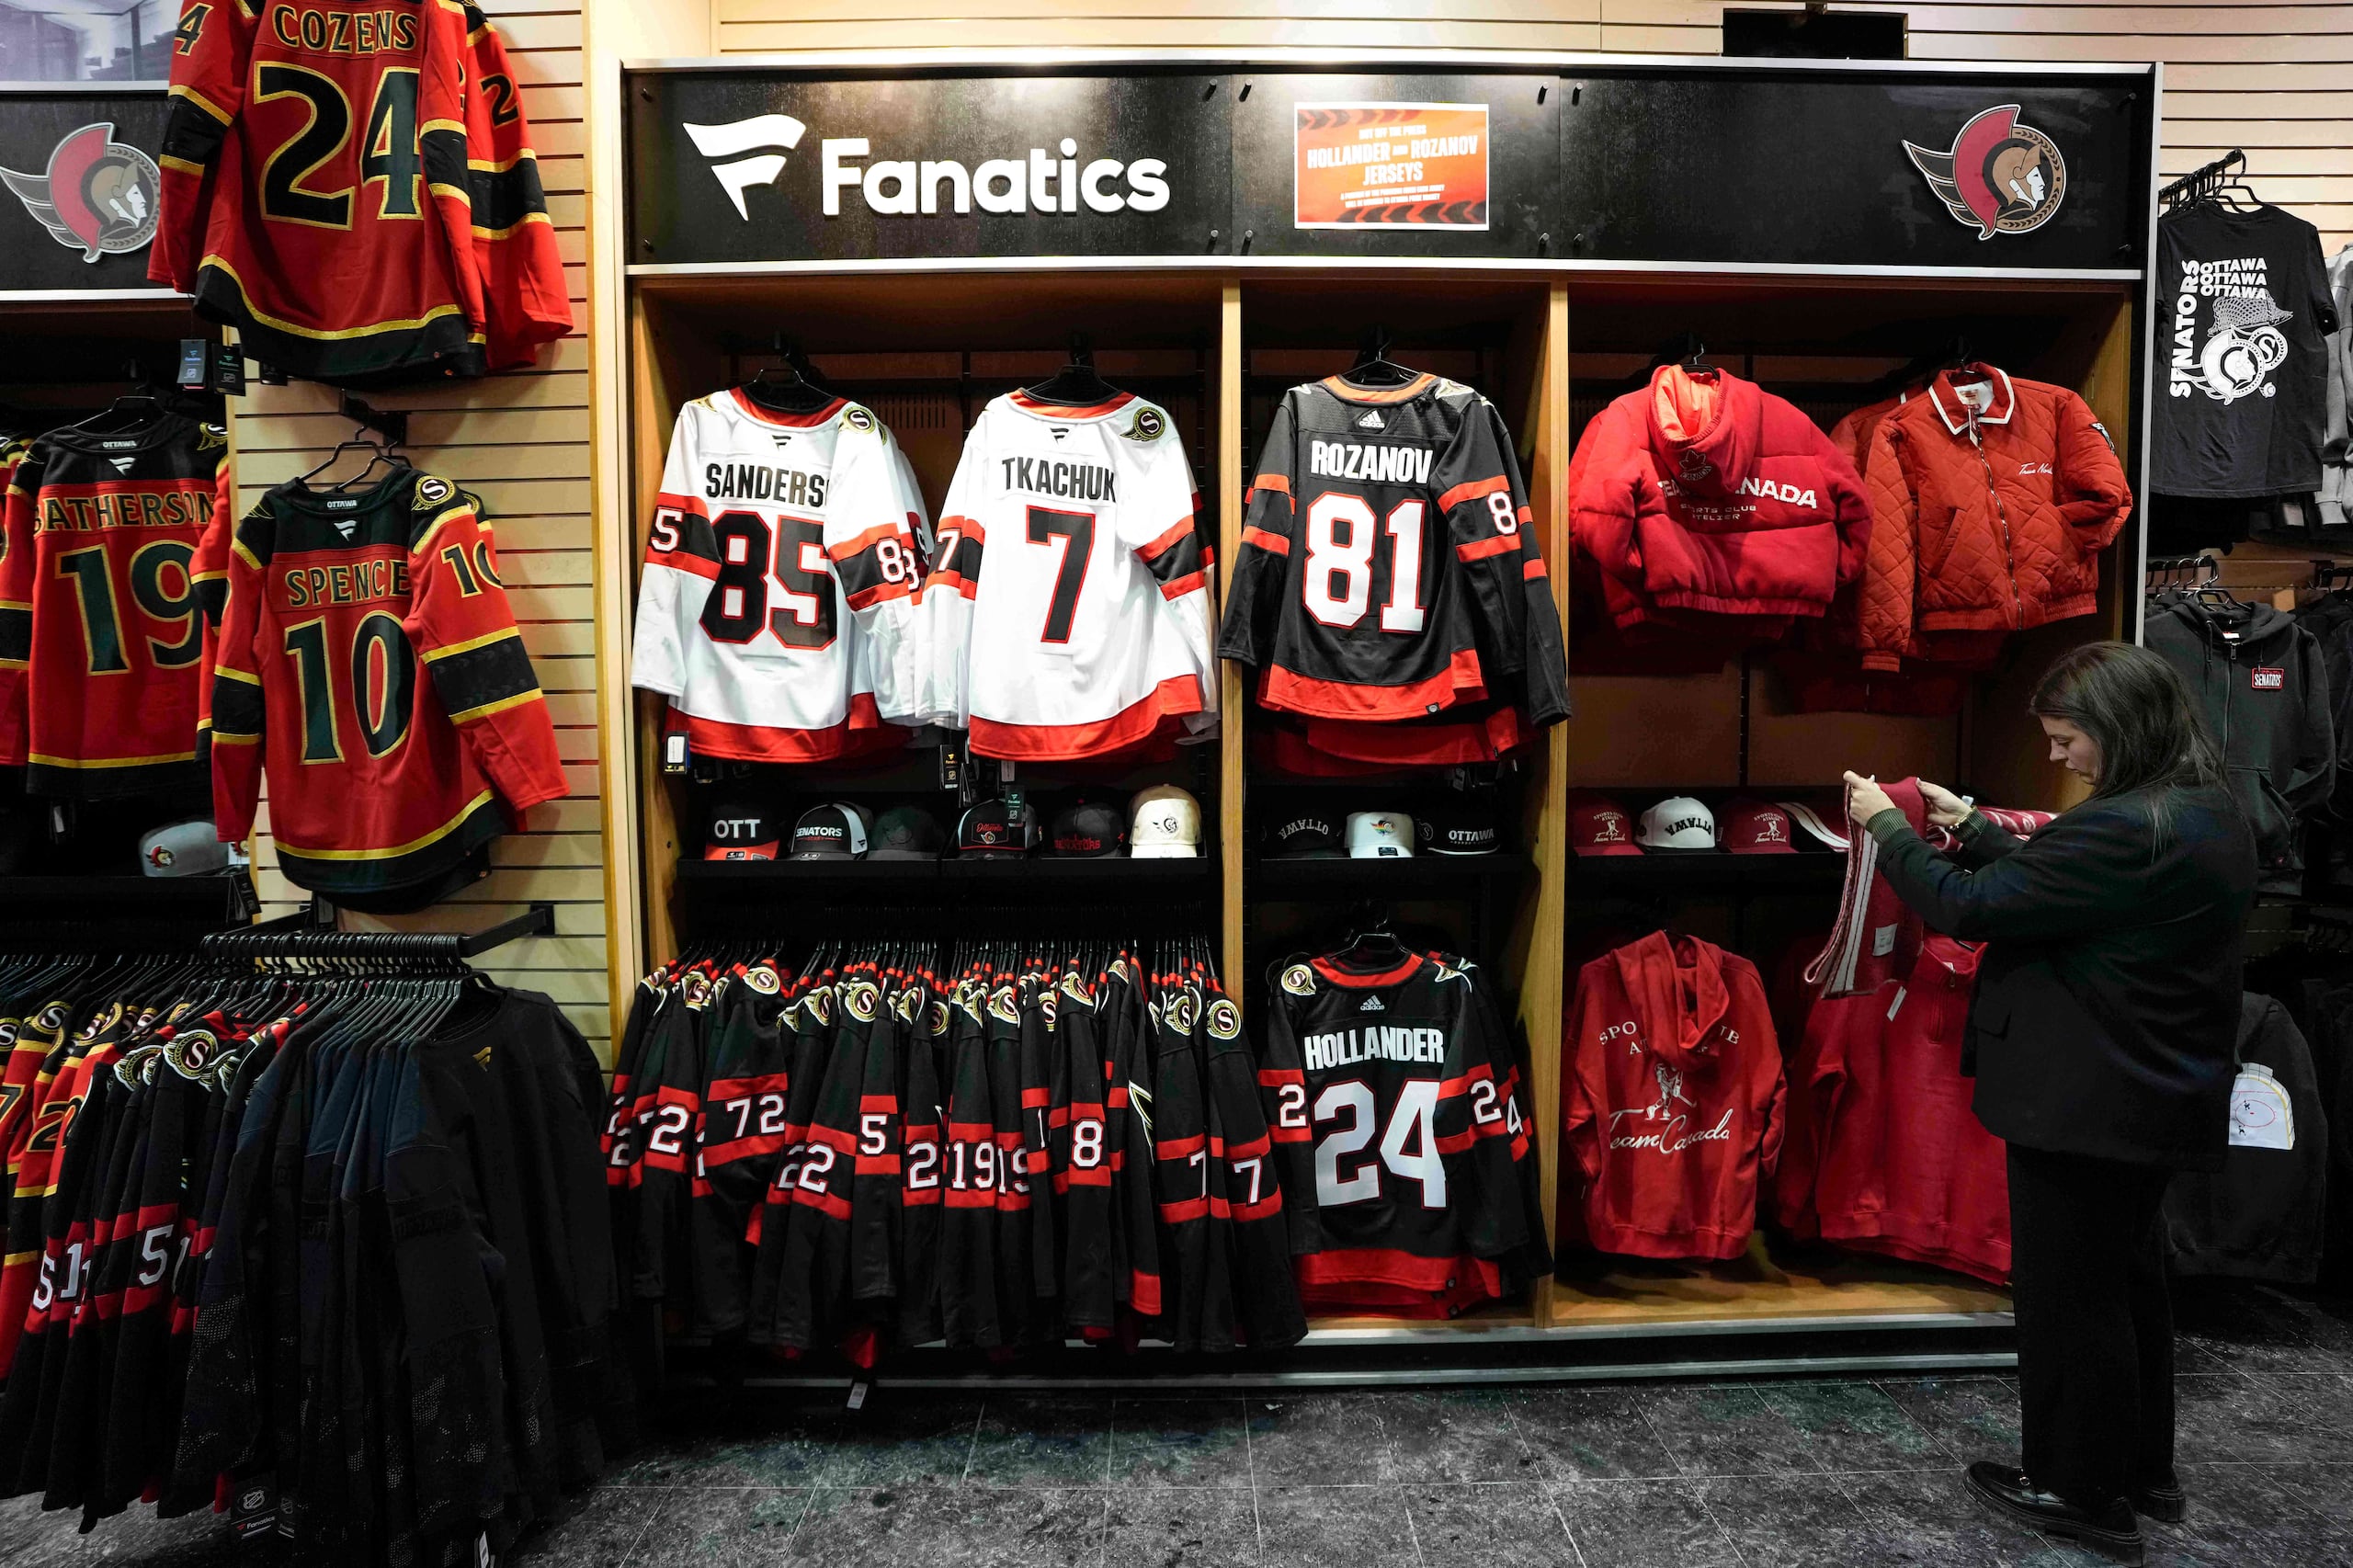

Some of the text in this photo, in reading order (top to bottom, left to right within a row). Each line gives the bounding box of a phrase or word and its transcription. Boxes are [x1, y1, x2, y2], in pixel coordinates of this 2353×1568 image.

[272, 4, 418, 54] COZENS
[480, 74, 519, 129] 2
[254, 60, 424, 231] 24
[1307, 142, 1391, 169] HOLLANDER
[1411, 135, 1478, 159] ROZANOV
[821, 138, 1171, 216] Fanatics
[1362, 162, 1423, 186] JERSEYS
[2200, 257, 2268, 274] OTTAWA
[2200, 273, 2268, 286] OTTAWA
[2200, 284, 2267, 301] OTTAWA
[2169, 259, 2200, 399] SENATORS
[103, 440, 137, 449] OTTAWA
[1358, 420, 1385, 428] adidas
[706, 462, 829, 507] SANDERS
[1002, 456, 1116, 503] TKACHUK
[1310, 440, 1433, 484] ROZANOV
[327, 500, 358, 508] OTTAWA
[1486, 489, 1517, 535] 8
[1735, 476, 1817, 509] NADA
[650, 506, 683, 551] 5
[937, 529, 962, 573] 7
[699, 510, 837, 652] 85
[1026, 505, 1096, 643] 7
[1302, 492, 1427, 634] 81
[54, 540, 203, 676] 19
[285, 610, 417, 765] 10
[2254, 672, 2281, 687] SENATORS
[713, 818, 761, 839] OTT
[795, 826, 843, 837] SENATORS
[1448, 828, 1495, 840] OTTAWA
[1360, 1003, 1385, 1011] adidas
[1303, 1025, 1445, 1071] HOLLANDER
[726, 1094, 785, 1139] 72
[1279, 1083, 1308, 1128] 2
[1471, 1078, 1503, 1125] 2
[649, 1104, 690, 1154] 2
[860, 1113, 888, 1155] 5
[1072, 1119, 1103, 1168] 8
[1312, 1077, 1448, 1210] 24
[1608, 1108, 1660, 1149] Team
[798, 1142, 835, 1193] 2
[907, 1142, 938, 1190] 2
[950, 1142, 995, 1190] 19
[1233, 1158, 1262, 1206] 7
[139, 1223, 175, 1286] 5
